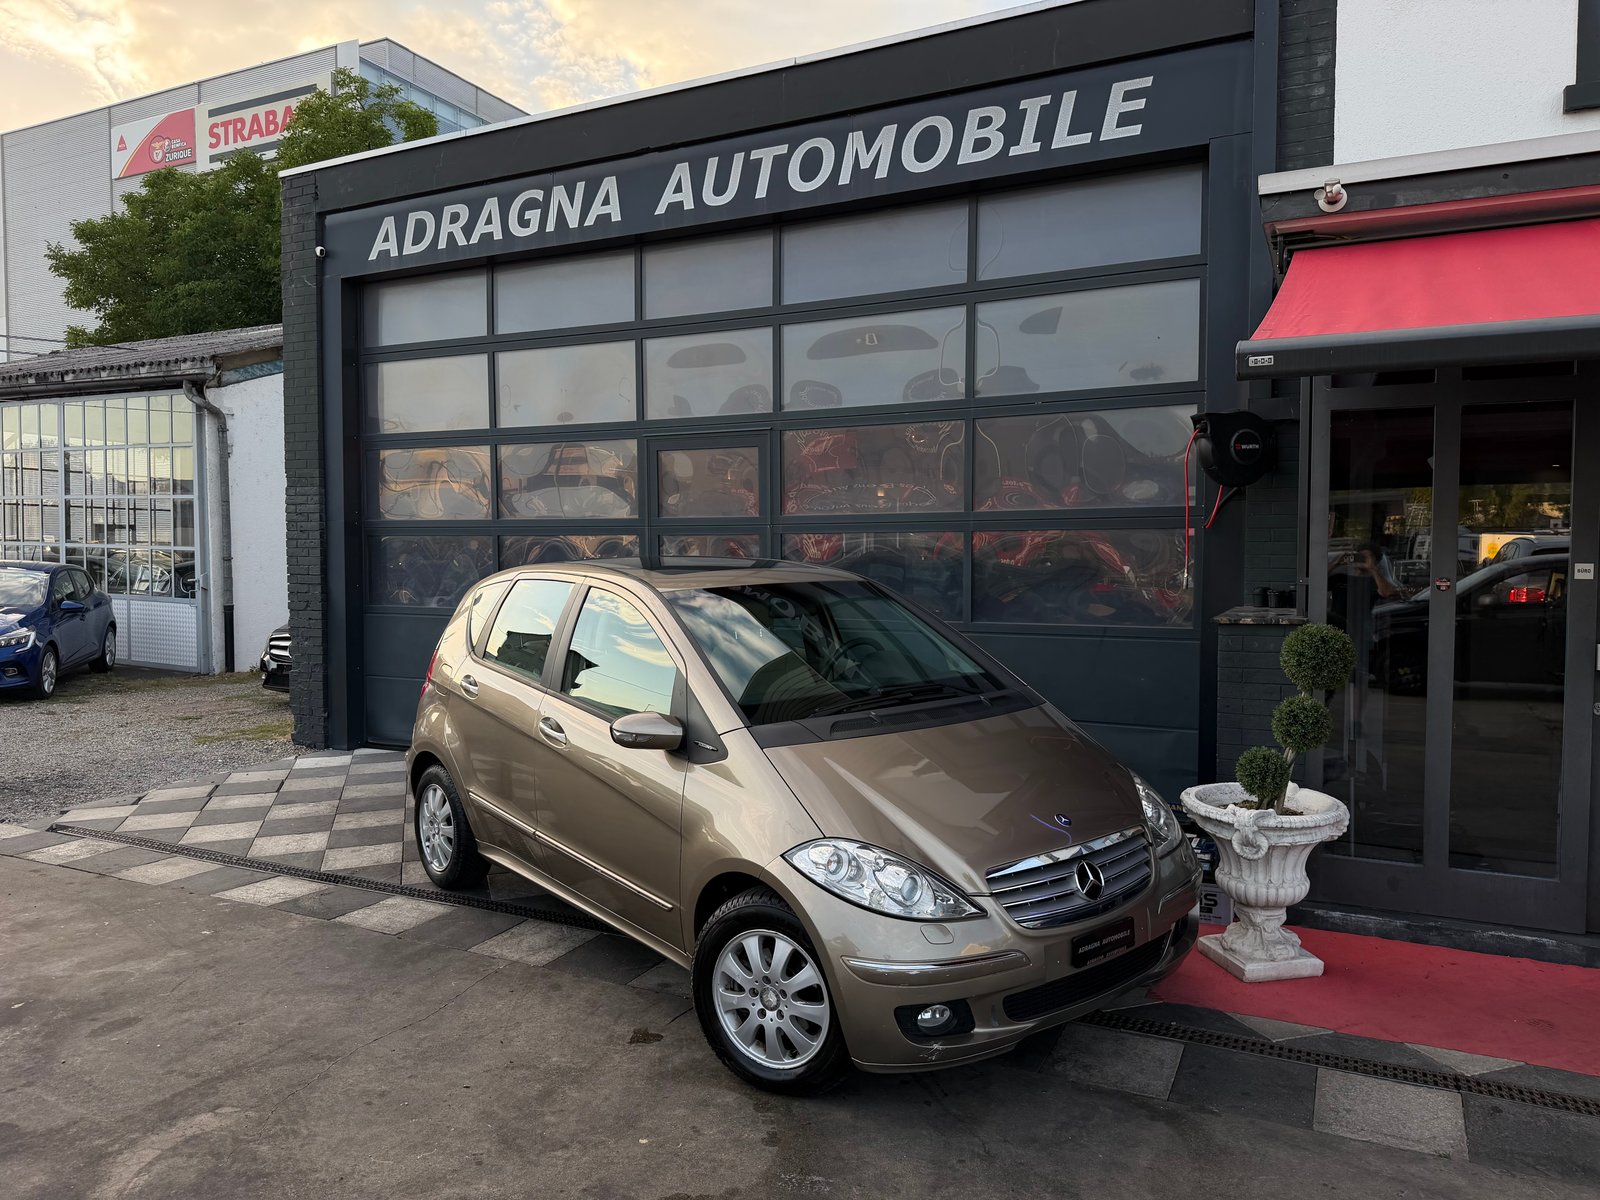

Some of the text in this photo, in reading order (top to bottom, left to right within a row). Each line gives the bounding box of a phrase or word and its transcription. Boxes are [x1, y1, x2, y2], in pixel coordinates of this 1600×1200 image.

[165, 148, 192, 162] ZURIQUE
[368, 75, 1154, 261] ADRAGNA AUTOMOBILE
[1078, 929, 1131, 955] ADRAGNA AUTOMOBILE
